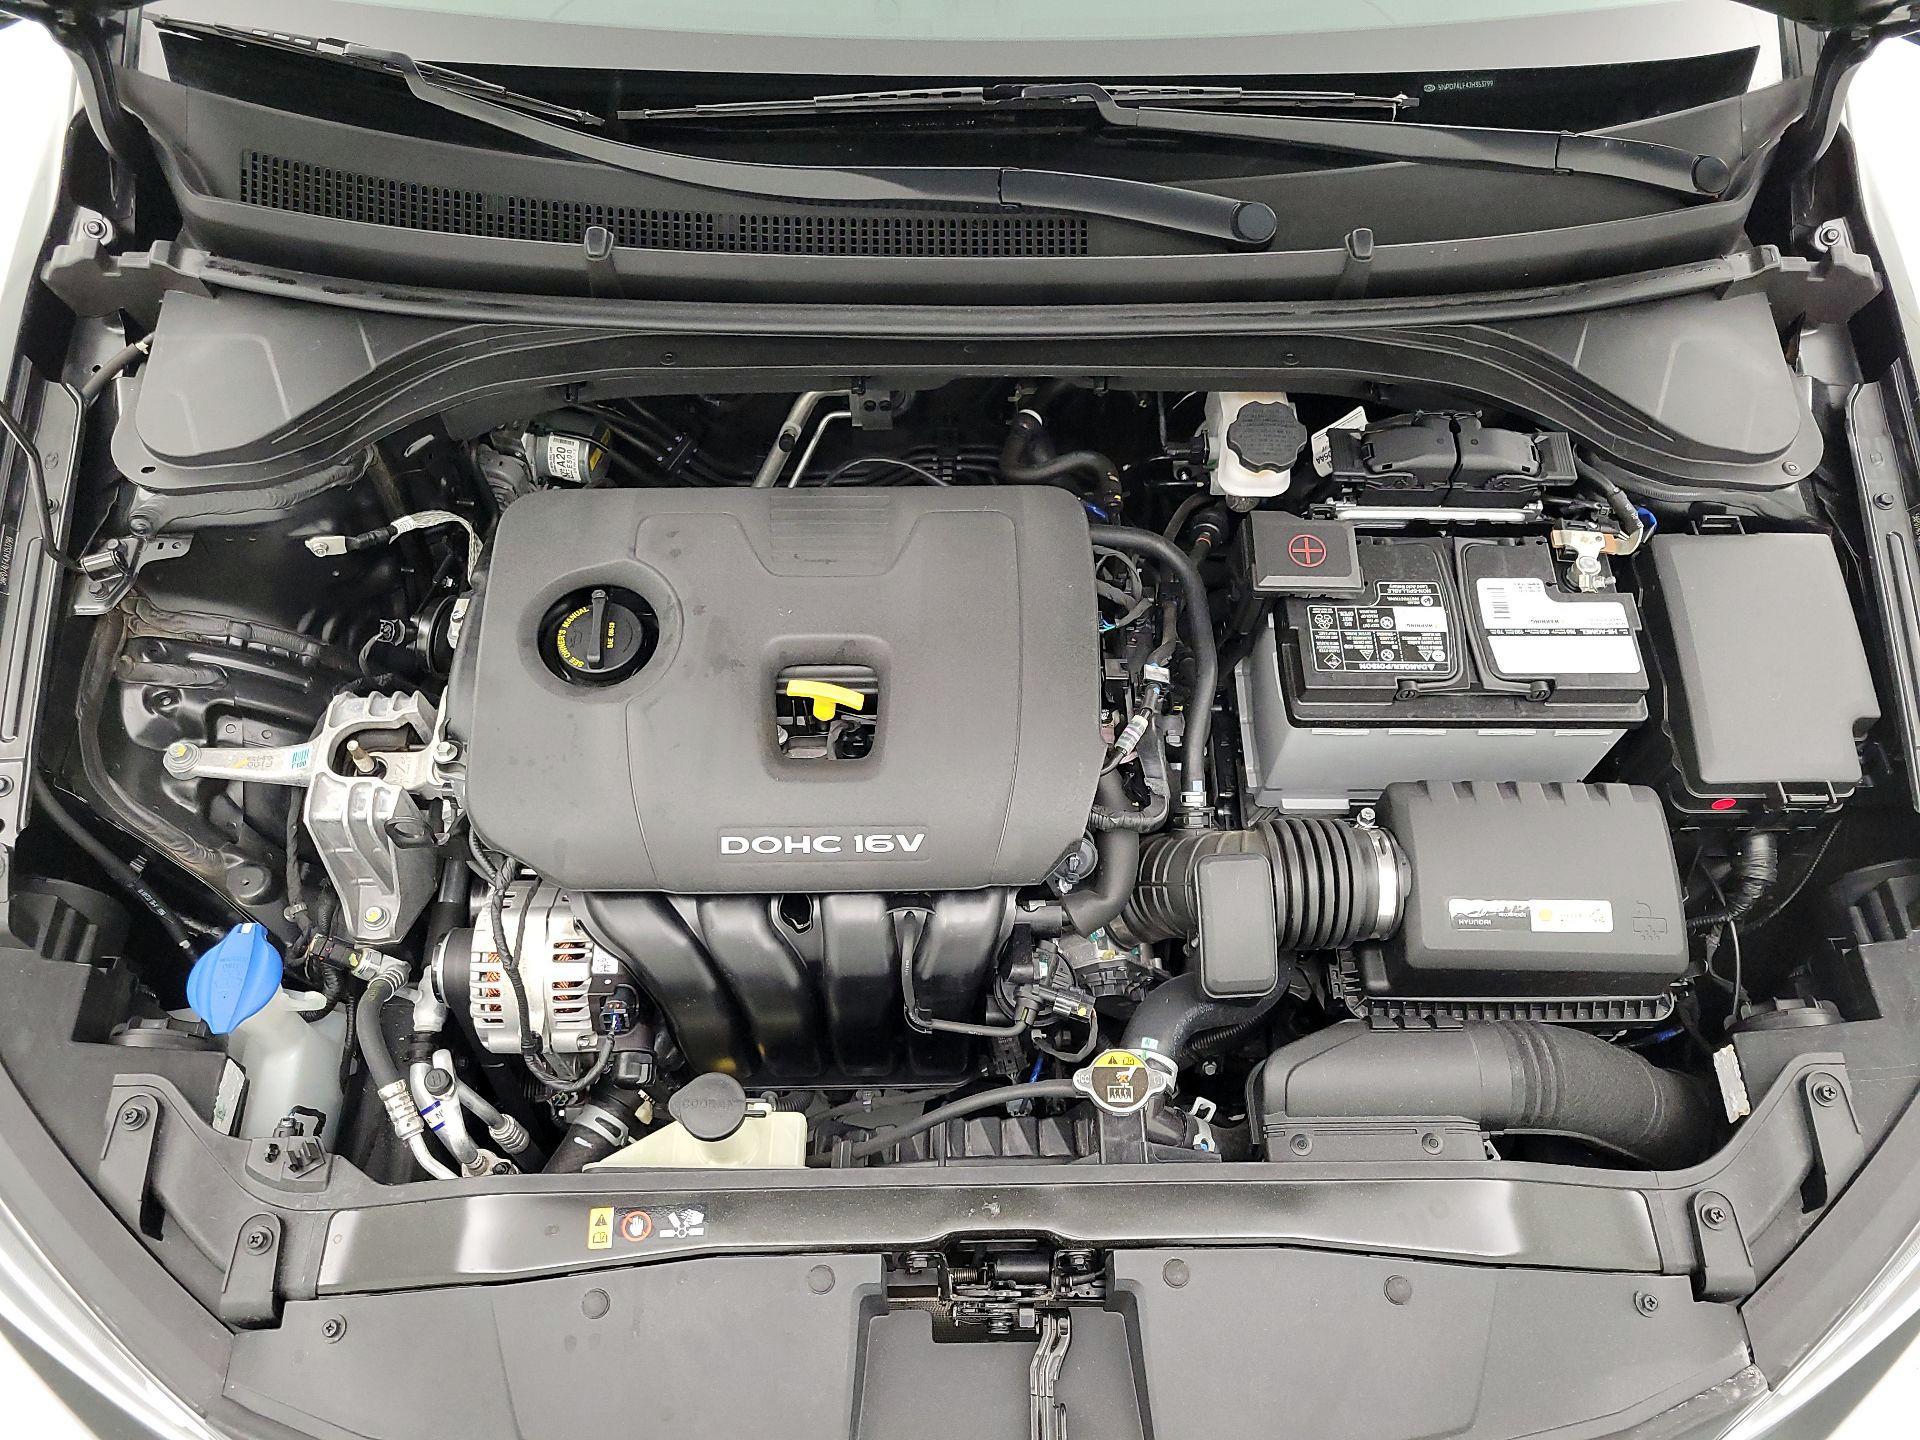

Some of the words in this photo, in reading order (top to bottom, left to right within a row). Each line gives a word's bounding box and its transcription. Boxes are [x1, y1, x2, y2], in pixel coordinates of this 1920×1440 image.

[555, 446, 566, 469] A20
[562, 606, 590, 628] MANUAL
[570, 656, 584, 668] SEE
[720, 835, 842, 855] DOHC
[853, 833, 925, 853] 16V
